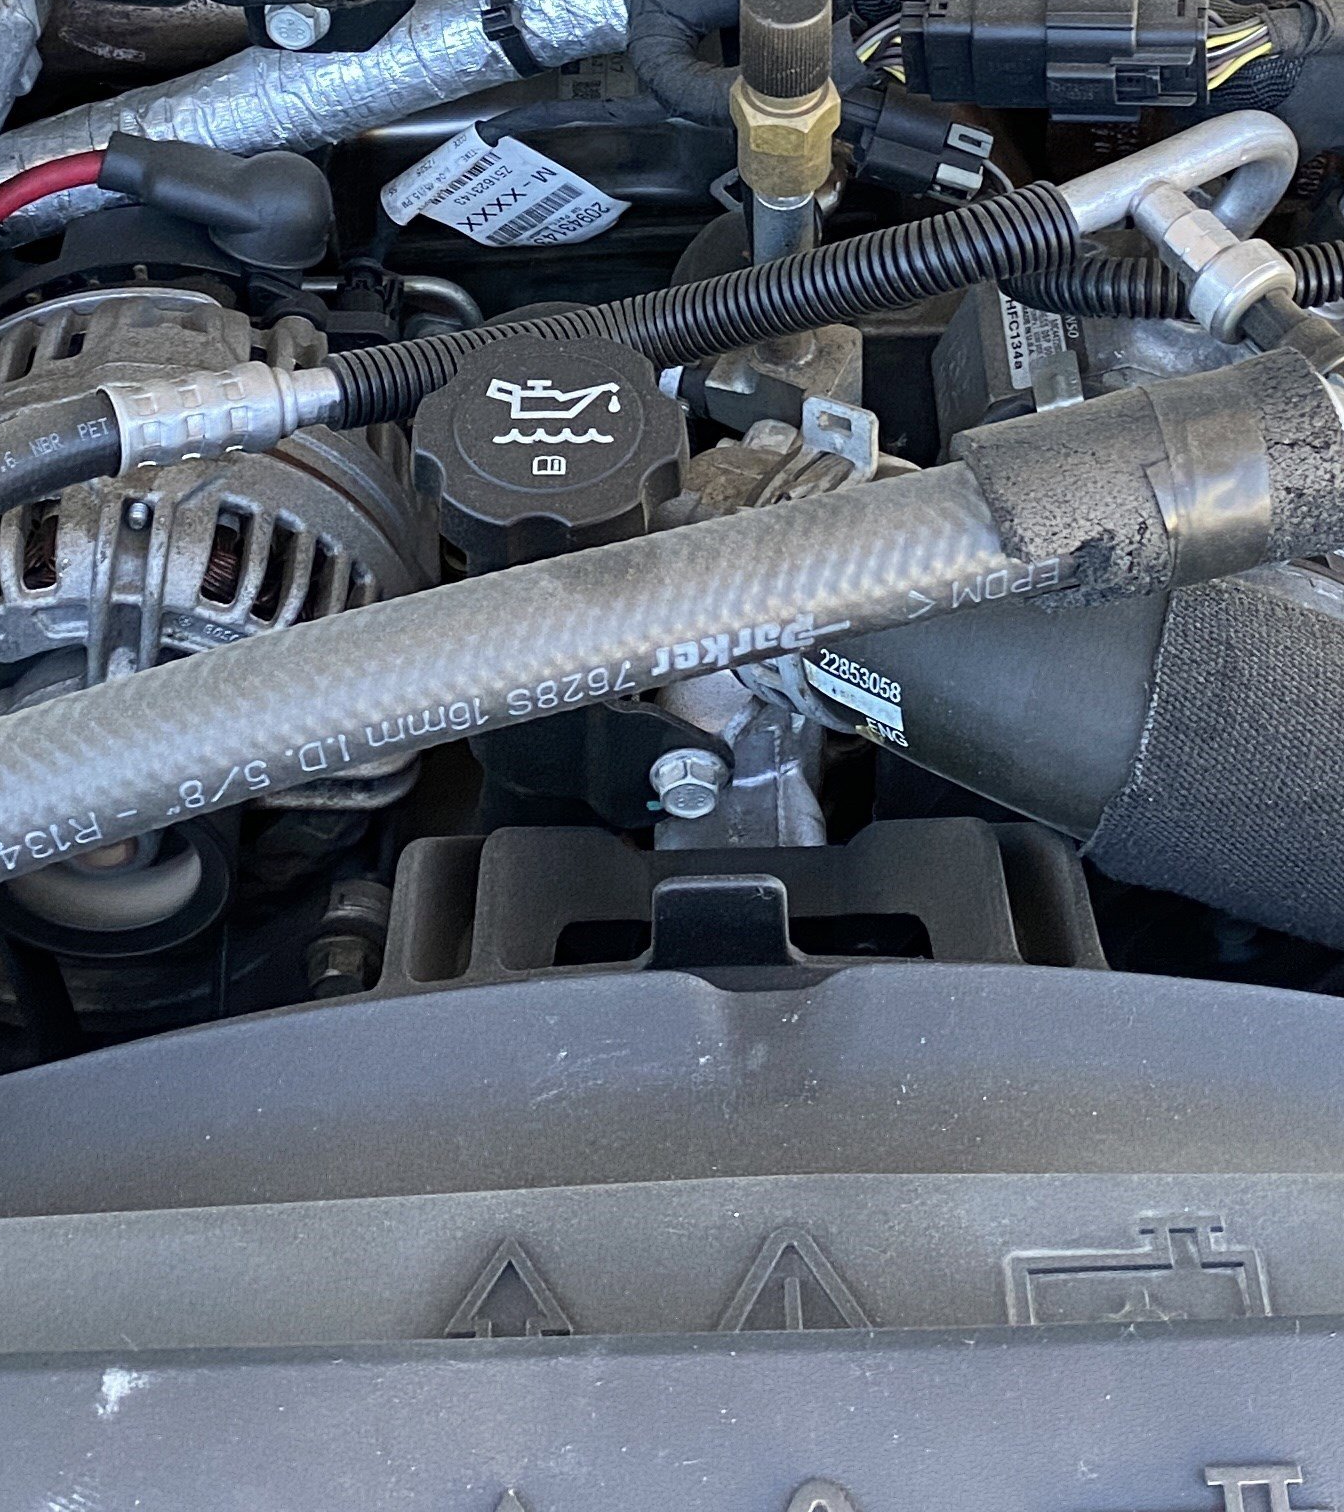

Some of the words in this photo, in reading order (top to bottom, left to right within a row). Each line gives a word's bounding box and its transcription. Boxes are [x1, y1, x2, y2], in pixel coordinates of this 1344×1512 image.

[453, 165, 514, 206] Z51623143
[1006, 299, 1024, 370] HFC134a
[29, 431, 66, 458] NBR
[76, 417, 112, 441] PET
[952, 557, 1060, 608] EPDM
[651, 614, 851, 676] Parker
[505, 659, 636, 717] 7628S
[819, 648, 902, 704] 22853058
[366, 698, 489, 748] 16mm
[865, 717, 909, 748] ENG
[284, 733, 352, 773] I.D.
